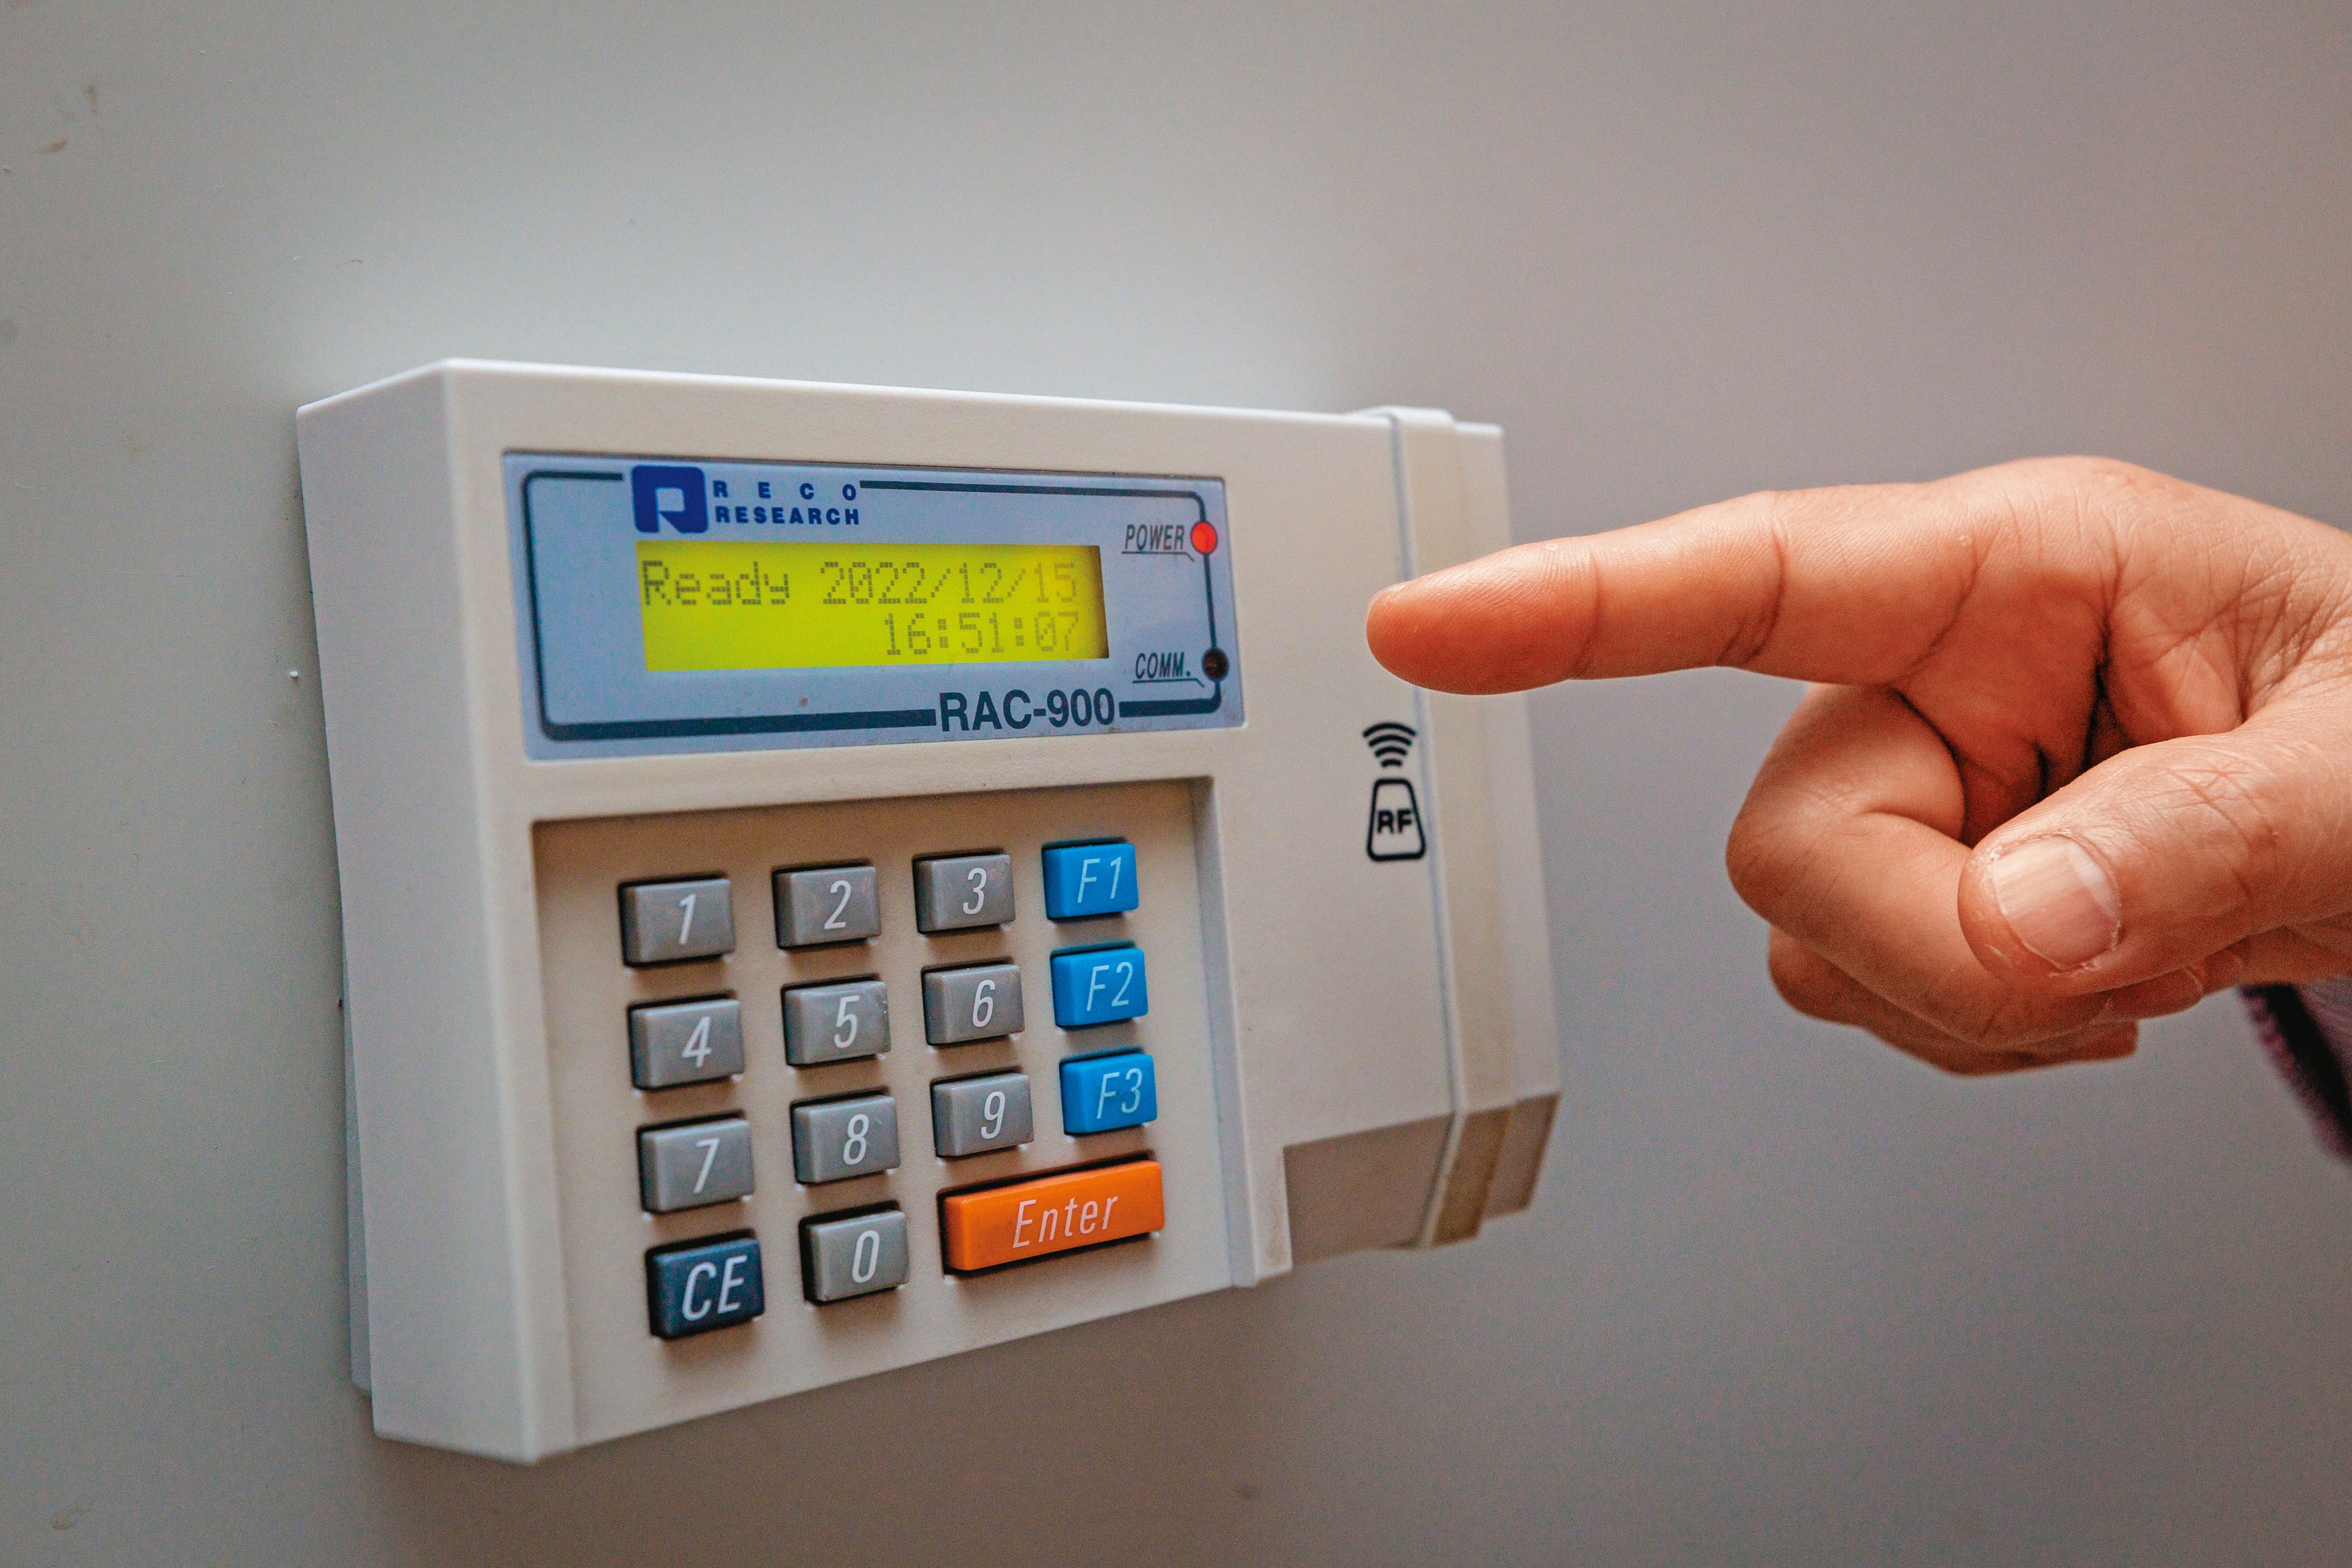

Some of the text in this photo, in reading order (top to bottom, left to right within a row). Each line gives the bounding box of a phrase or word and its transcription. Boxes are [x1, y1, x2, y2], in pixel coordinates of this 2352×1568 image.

[715, 506, 859, 525] RESEARCH
[1125, 524, 1185, 551] POWER
[642, 560, 1077, 606] Ready 2022/12/15
[884, 612, 1079, 655] 16:51:07
[1135, 652, 1191, 679] COMM.
[939, 688, 1115, 732] RAC-900
[1377, 809, 1413, 834] RF
[962, 867, 987, 914] 3
[1077, 856, 1121, 903] F1
[679, 893, 696, 945] 1
[824, 880, 851, 930] 2
[971, 979, 996, 1028] 6
[1086, 961, 1133, 1011] F2
[682, 1016, 712, 1068] 4
[833, 995, 860, 1048] 5
[981, 1091, 1006, 1140] 9
[1096, 1068, 1142, 1119] F3
[842, 1114, 869, 1165] 8
[693, 1137, 720, 1194] 7
[1012, 1196, 1118, 1249] Enter
[851, 1229, 880, 1283] 0
[682, 1254, 748, 1321] CE
